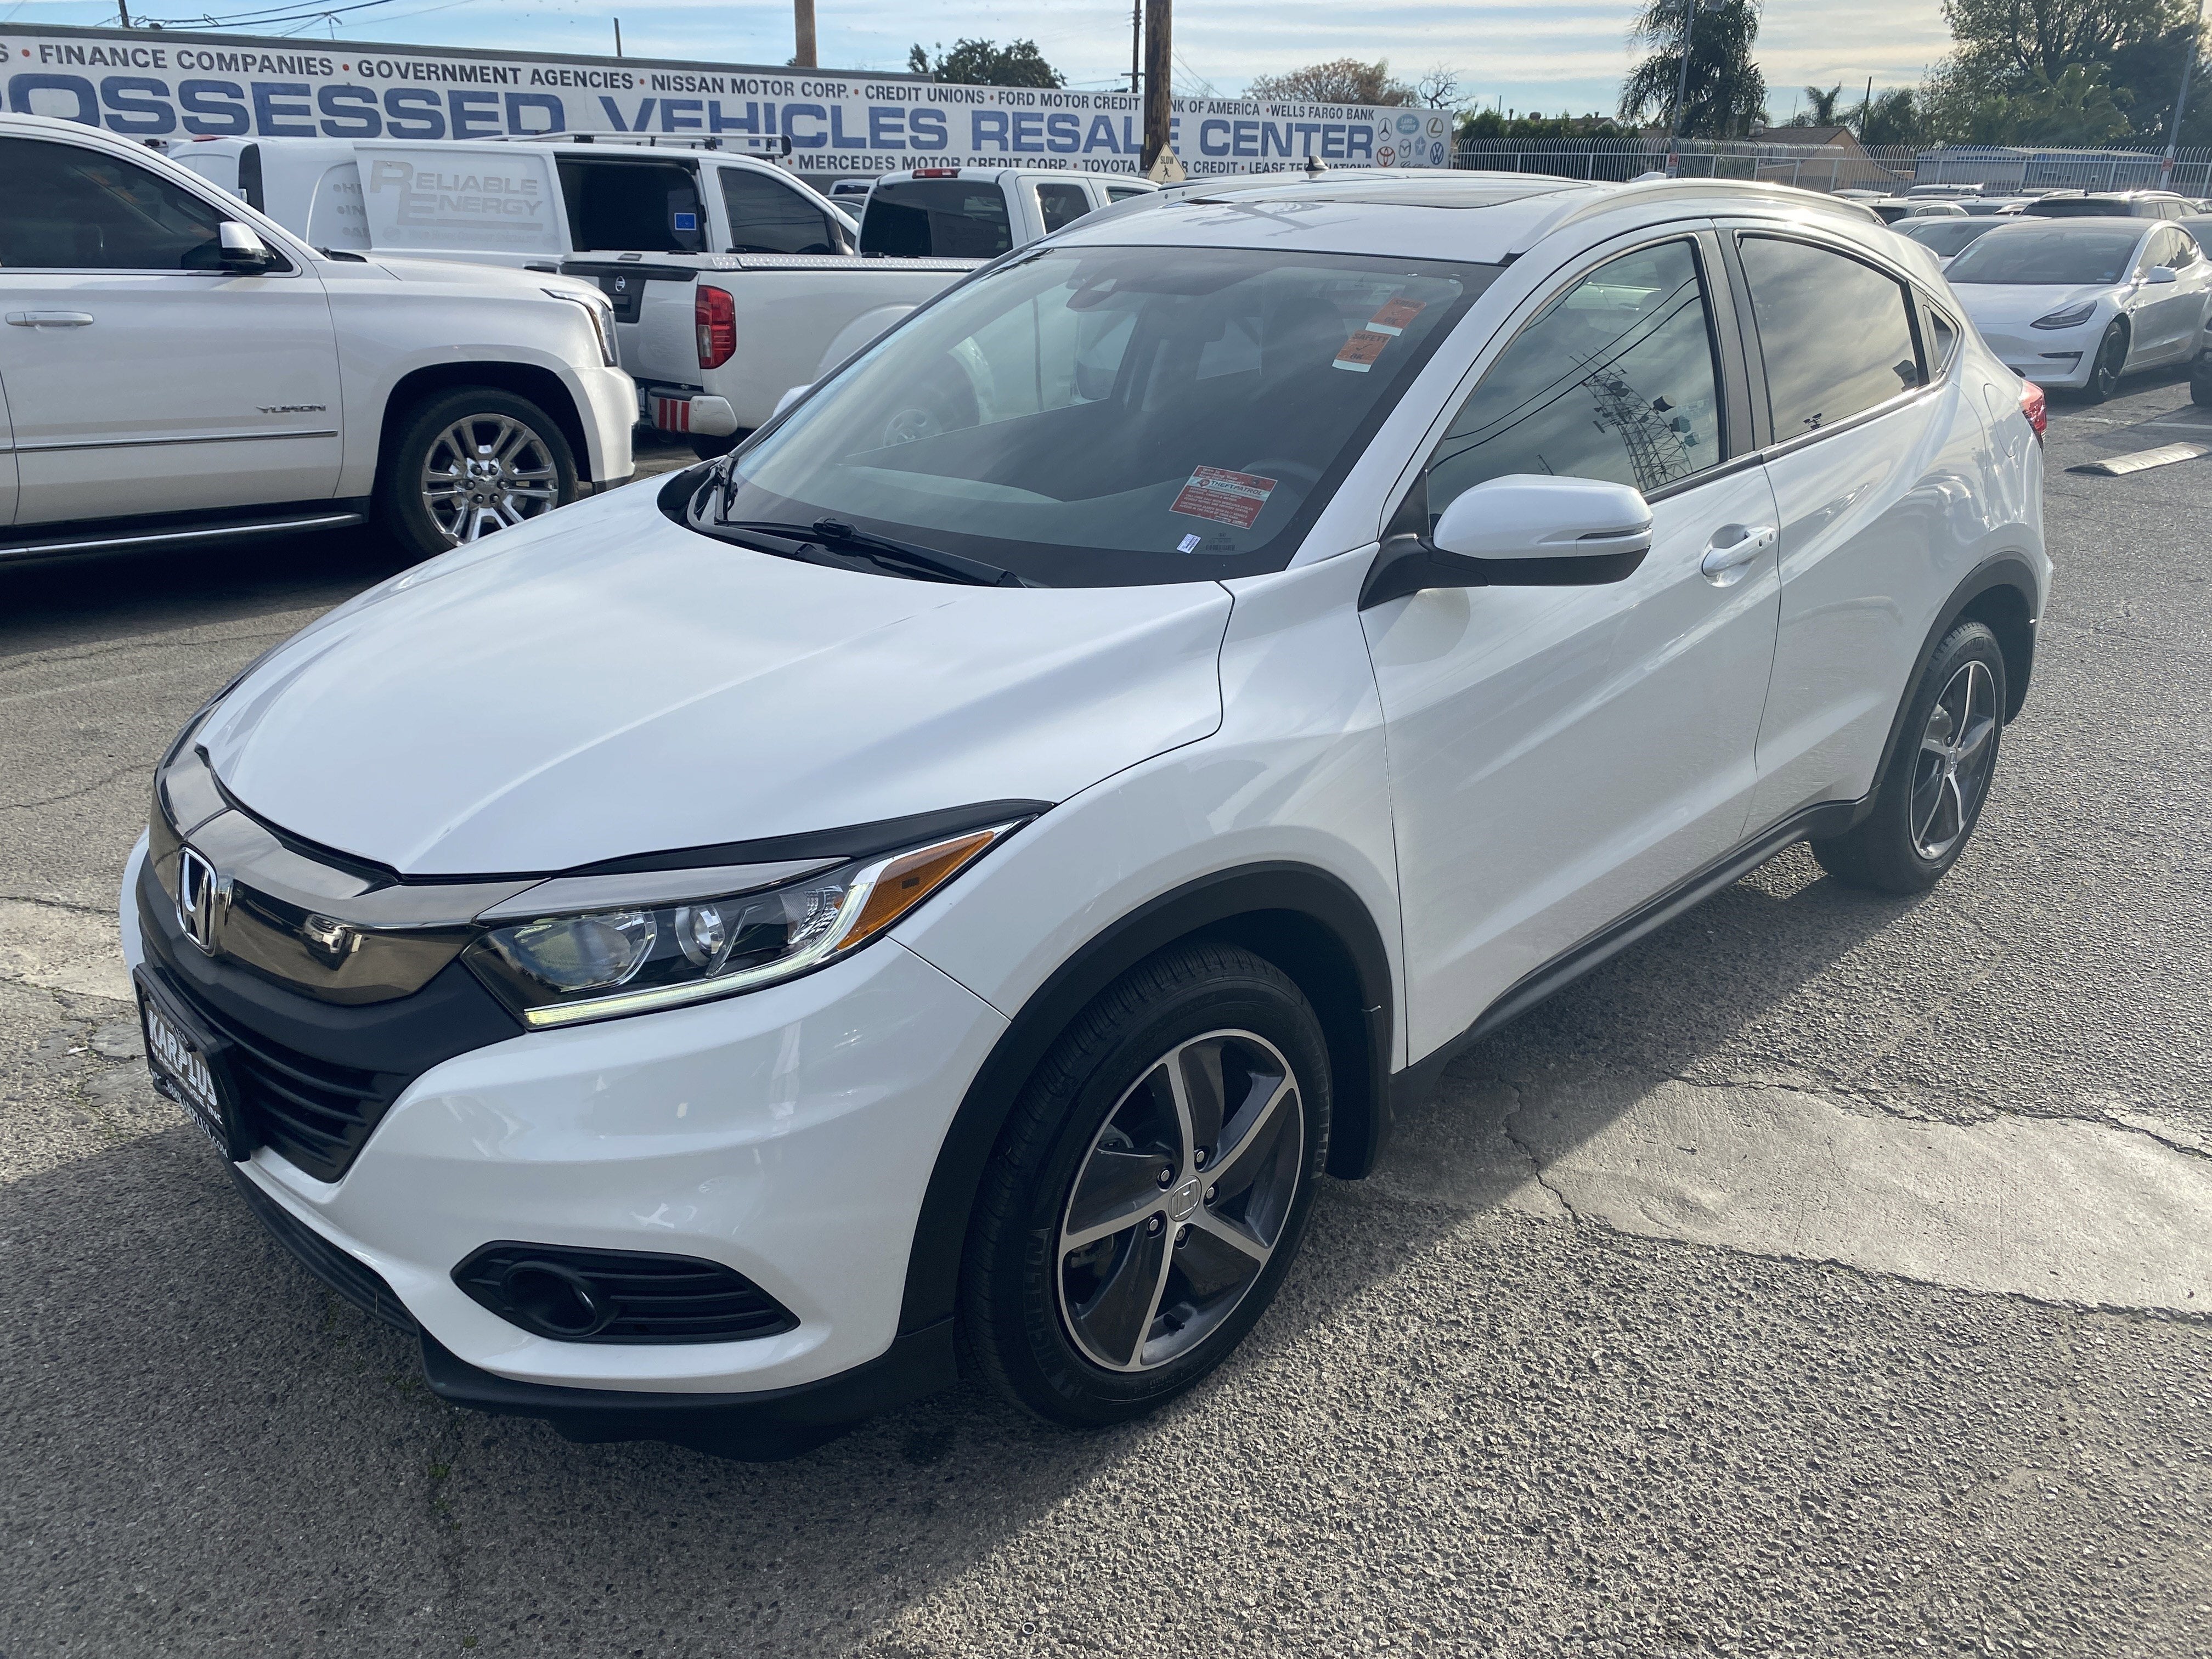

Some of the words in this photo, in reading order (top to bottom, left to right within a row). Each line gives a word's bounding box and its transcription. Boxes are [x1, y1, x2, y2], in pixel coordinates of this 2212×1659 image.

[38, 44, 167, 70] FINANCE
[178, 50, 334, 76] COMPANIES
[358, 59, 522, 86] GOVERNMENT
[531, 69, 633, 89] AGENCIES
[651, 74, 724, 93] NISSAN
[731, 78, 794, 96] MOTOR
[801, 82, 849, 98] CORP.
[865, 85, 923, 102] CREDIT
[927, 87, 985, 105] UNIONS
[998, 91, 1035, 106] FORD
[1040, 93, 1089, 109] MOTOR
[1094, 95, 1141, 111] CREDIT
[1170, 99, 1185, 114] NK
[1189, 101, 1205, 115] OF
[1207, 103, 1261, 117] AMERICA
[0, 72, 566, 140] OSSESSED
[597, 96, 948, 150] VEHICLES
[1200, 119, 1373, 159] CENTER
[1271, 104, 1305, 119] WELLS
[1308, 106, 1343, 120] FARGO
[1347, 108, 1375, 122] BANK
[798, 155, 897, 171] MERCEDES
[901, 156, 960, 170] MOTOR
[967, 157, 1023, 170] CREDIT
[1026, 158, 1068, 171] CORP.
[1082, 159, 1137, 173] TOYOTA
[1160, 155, 1174, 165] SLOW
[1193, 160, 1237, 174] CREDIT
[1249, 161, 1285, 174] LEASE
[370, 160, 538, 195] RELIABLE
[397, 188, 543, 225] ENERGY
[1384, 317, 1397, 325] OK
[1352, 333, 1389, 343] SAFETY
[1210, 481, 1264, 495] THEFTPATROL
[148, 1008, 218, 1106] KARPLUS
[150, 1041, 206, 1109] WAREHOUSE
[206, 1103, 223, 1125] INC
